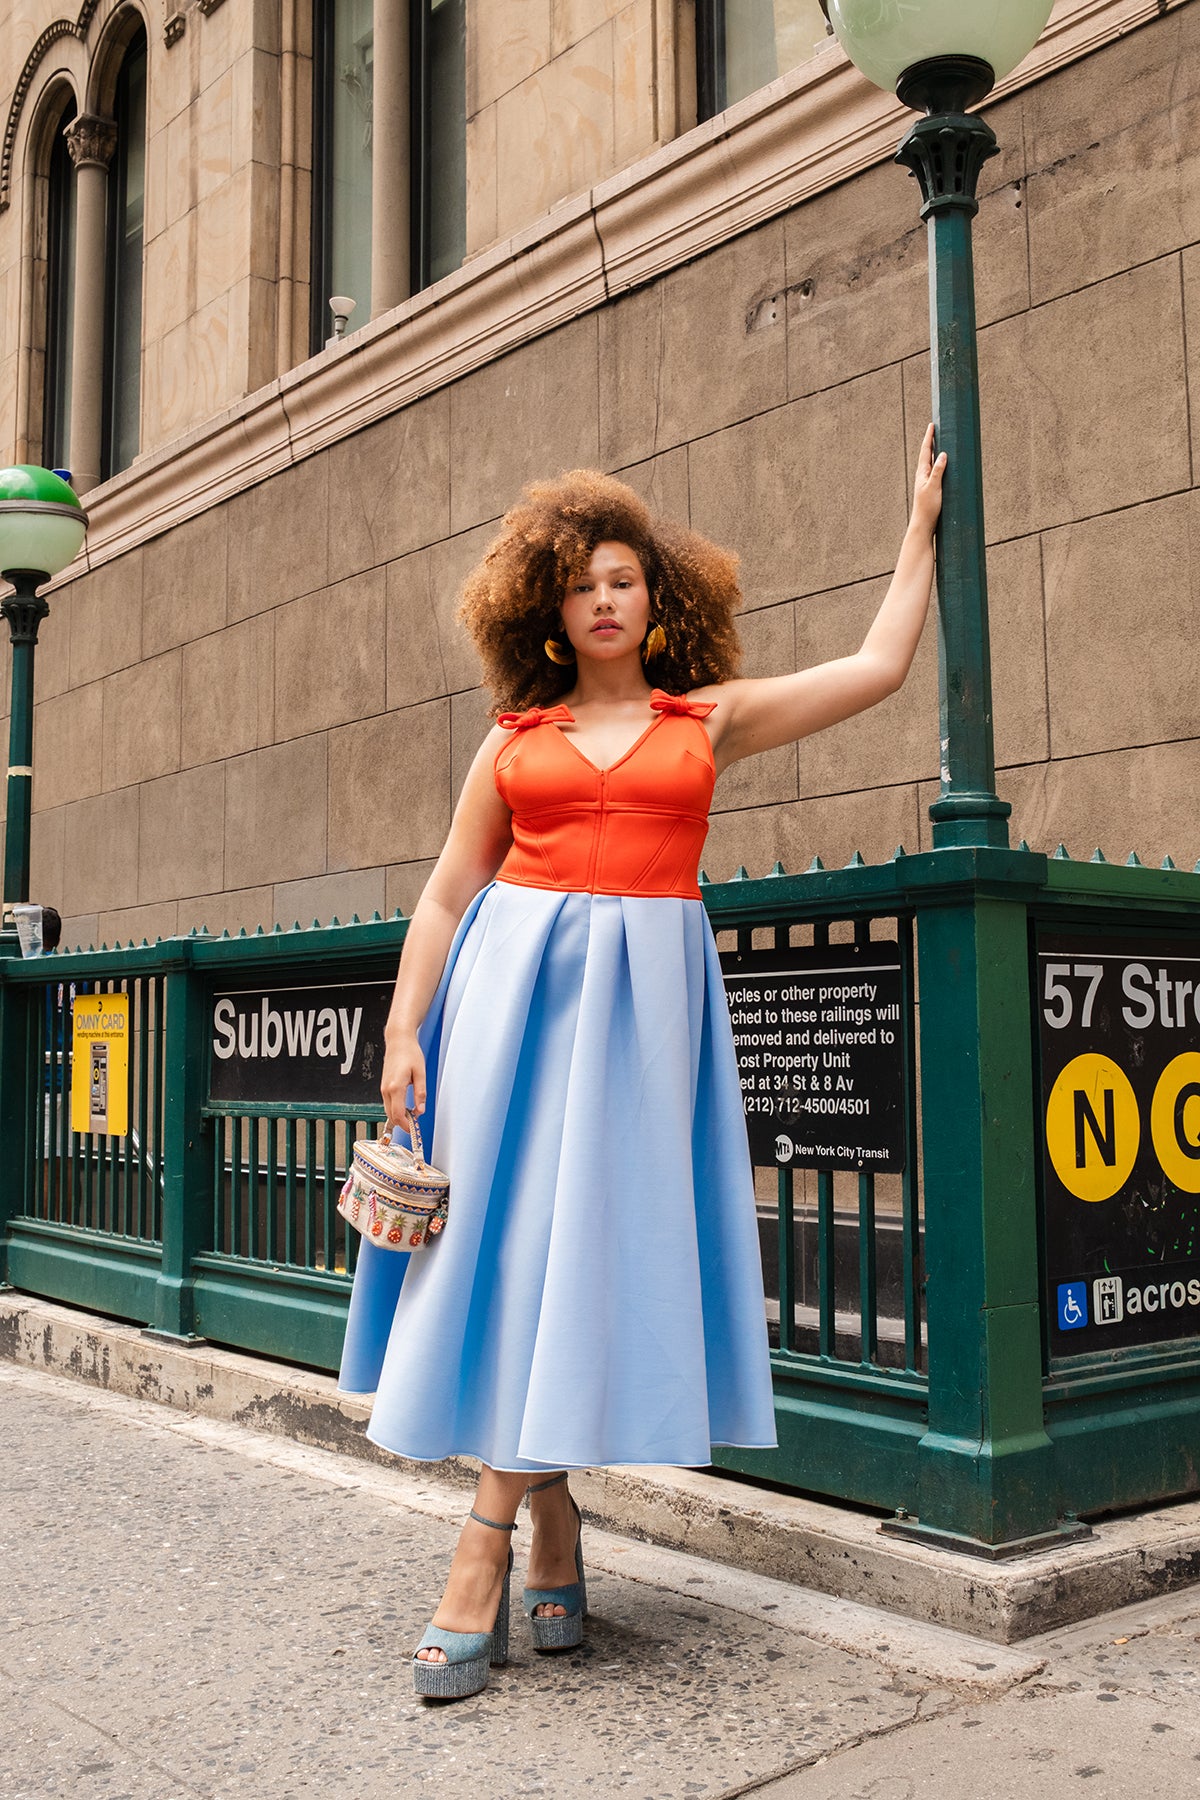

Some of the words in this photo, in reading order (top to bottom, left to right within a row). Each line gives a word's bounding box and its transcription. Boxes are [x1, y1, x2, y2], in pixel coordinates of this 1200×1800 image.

[764, 989, 778, 1002] or
[781, 985, 815, 1001] other
[819, 983, 877, 1003] property
[1043, 963, 1104, 1029] 57
[1122, 963, 1200, 1029] Str
[76, 1014, 100, 1030] OMNY
[101, 1013, 125, 1030] CARD
[729, 1009, 762, 1025] ched
[765, 1009, 778, 1024] to
[781, 1008, 818, 1024] these
[821, 1006, 872, 1026] railings
[876, 1004, 900, 1021] will
[213, 997, 363, 1075] Subway
[785, 1029, 810, 1046] and
[813, 1028, 877, 1045] delivered
[880, 1029, 895, 1044] to
[763, 1052, 819, 1072] Property
[823, 1052, 851, 1068] Unit
[758, 1075, 771, 1090] at
[773, 1074, 789, 1091] 34
[793, 1074, 807, 1091] St
[810, 1075, 820, 1091] &
[824, 1075, 832, 1091] 8
[836, 1075, 854, 1091] Av
[1073, 1089, 1116, 1169] N
[795, 1144, 814, 1155] New
[815, 1145, 836, 1157] York
[837, 1146, 855, 1160] City
[856, 1147, 889, 1159] Transit
[1126, 1279, 1200, 1315] acros
